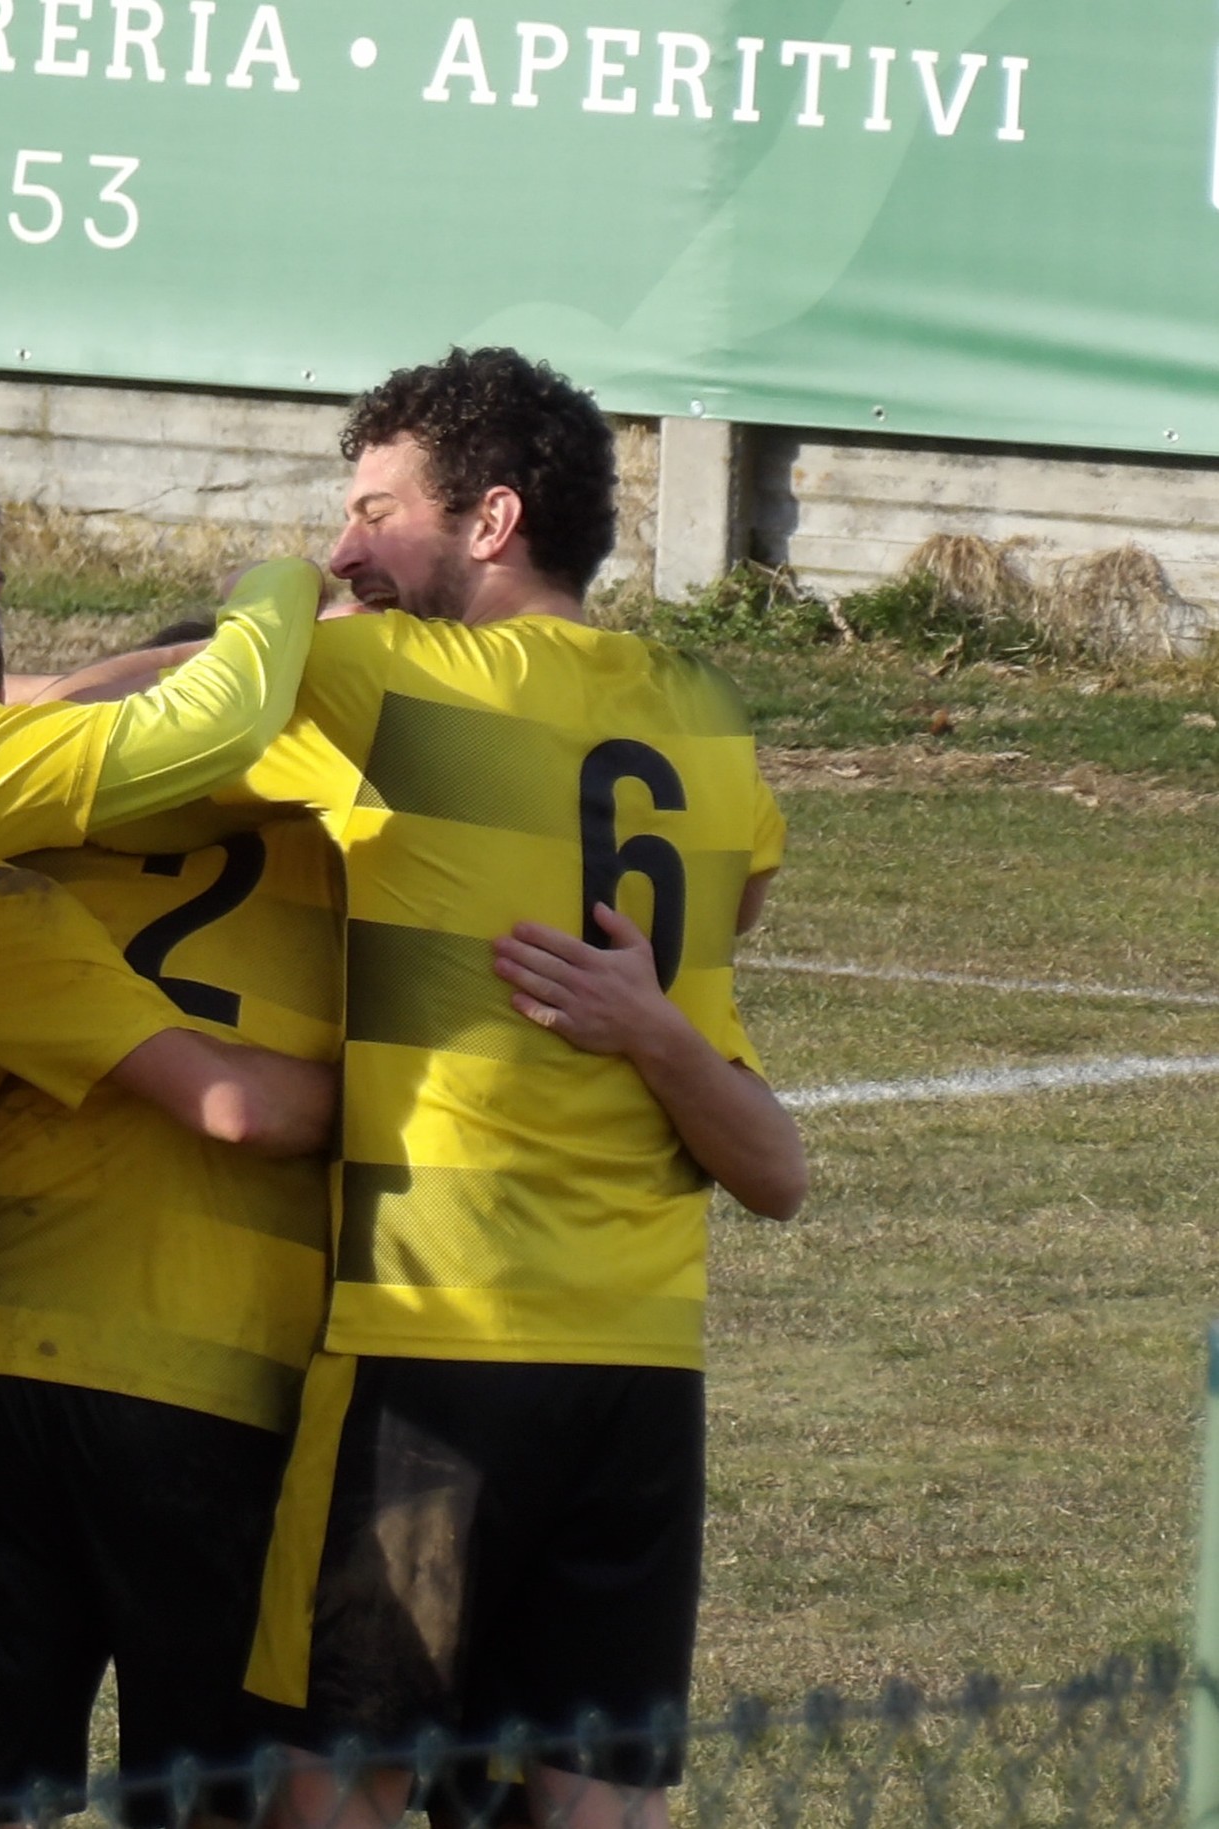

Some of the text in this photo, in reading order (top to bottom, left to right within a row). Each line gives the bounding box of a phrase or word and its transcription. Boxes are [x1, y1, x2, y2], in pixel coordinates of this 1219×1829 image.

[422, 17, 1028, 141] APERITIVI
[123, 831, 267, 1028] 2
[580, 738, 687, 994] 6
